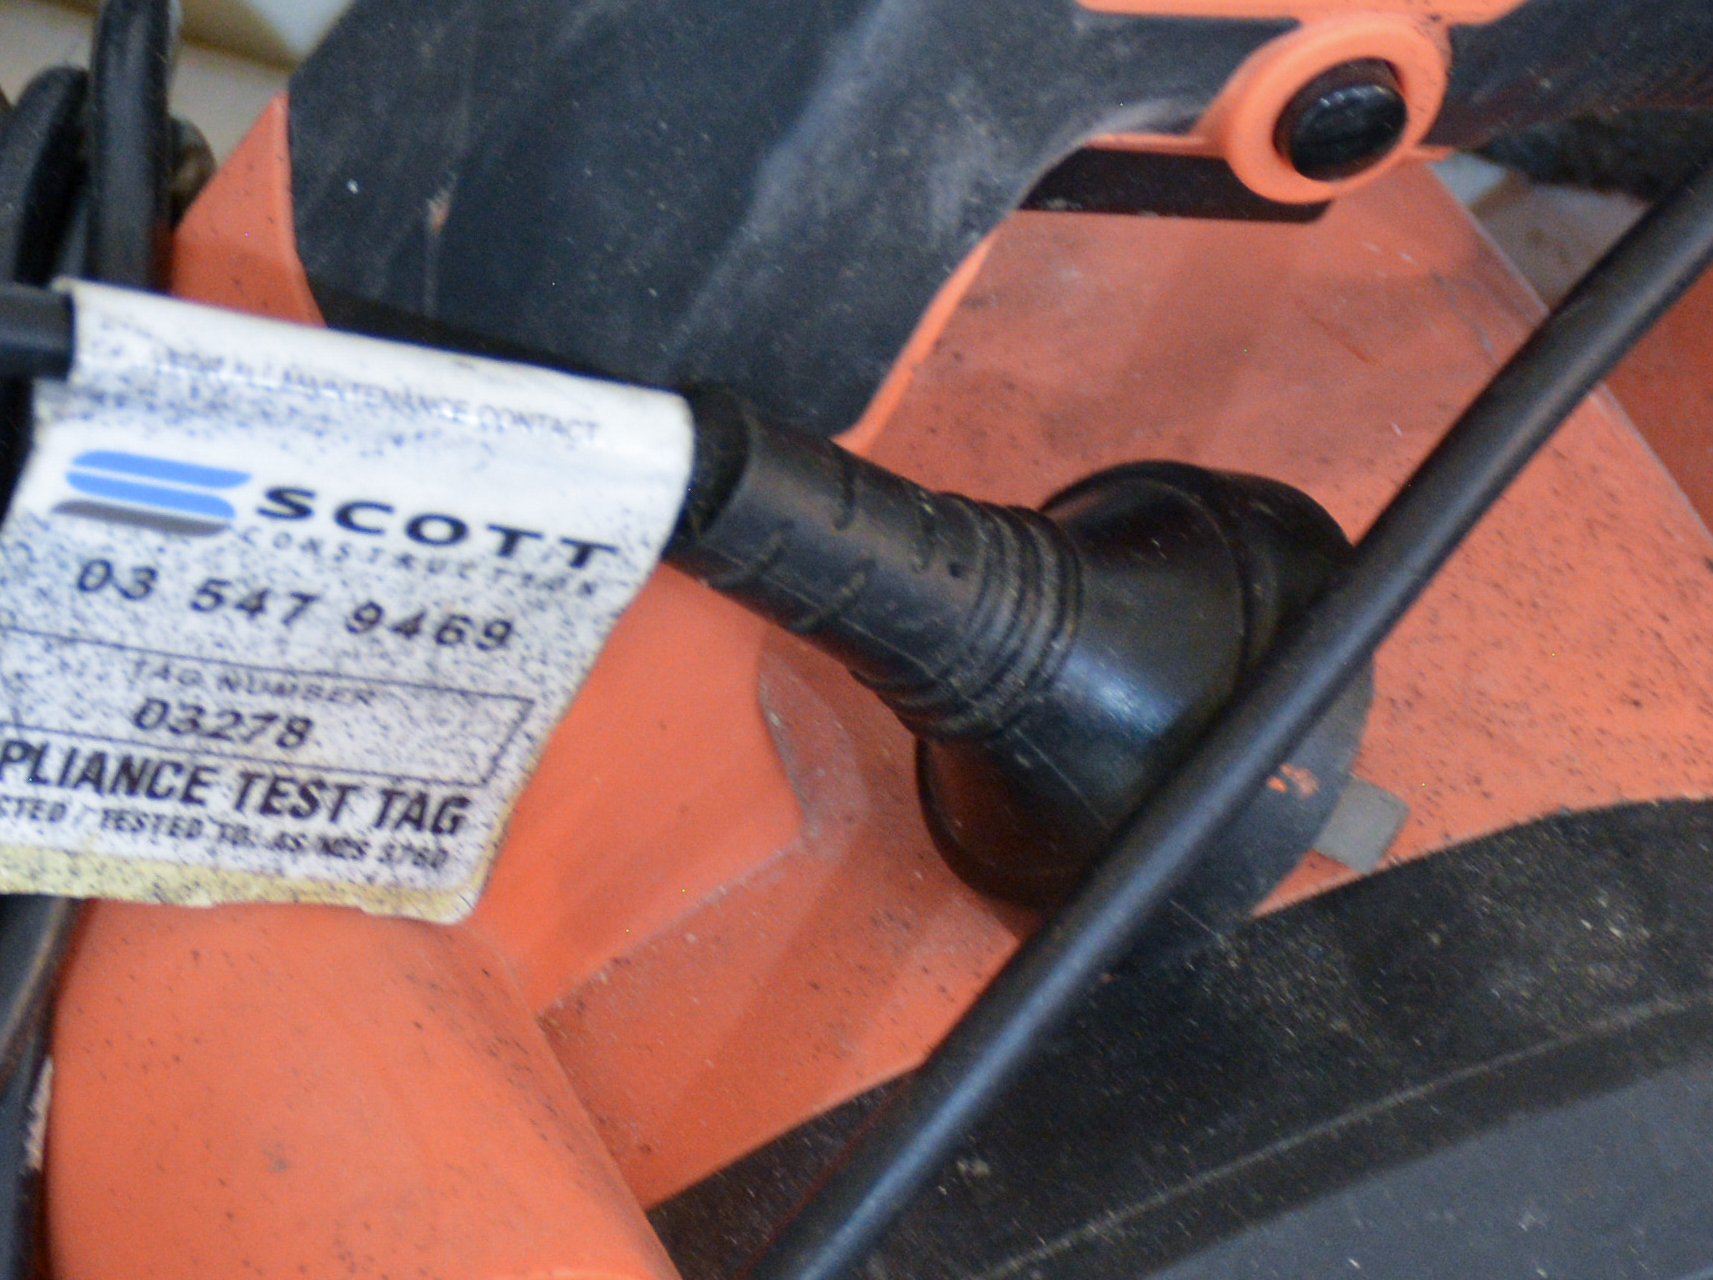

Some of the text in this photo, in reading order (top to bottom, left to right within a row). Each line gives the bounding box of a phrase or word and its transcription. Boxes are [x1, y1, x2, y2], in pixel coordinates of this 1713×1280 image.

[254, 484, 620, 569] SCOTT
[238, 525, 599, 598] CONSTRUCTION
[76, 558, 514, 652] 03 547 9469
[217, 668, 376, 707] NUMBER
[133, 696, 315, 751] 03278
[99, 807, 205, 841] TESTED
[234, 771, 363, 825] TEST
[372, 788, 472, 836] TAG
